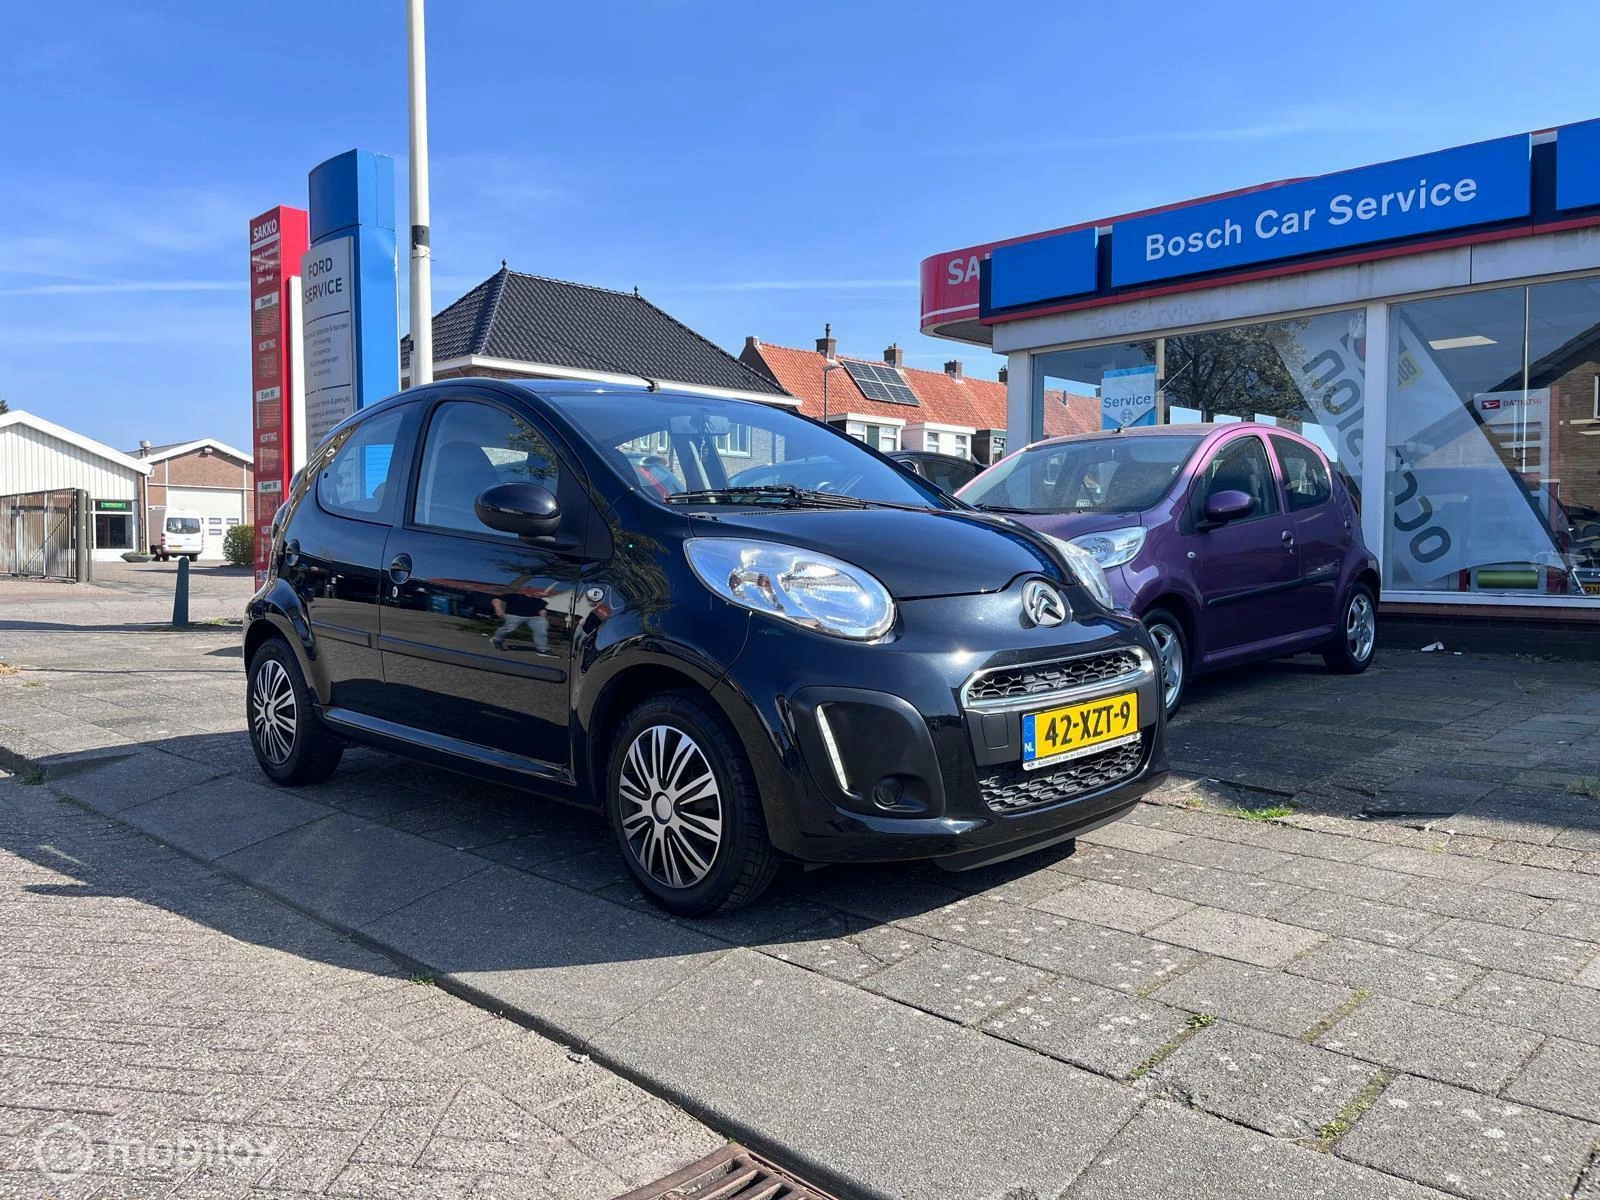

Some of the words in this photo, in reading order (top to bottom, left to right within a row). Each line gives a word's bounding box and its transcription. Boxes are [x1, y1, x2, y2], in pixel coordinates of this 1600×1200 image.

[253, 218, 278, 242] SAKKO
[1145, 218, 1243, 262] Bosch
[1255, 207, 1316, 240] Car
[1328, 178, 1478, 226] Service
[308, 256, 333, 280] FORD
[947, 253, 991, 286] SA
[304, 277, 343, 305] SERVICE
[1103, 394, 1151, 409] Service
[1044, 700, 1131, 748] 42-XZT-9
[1024, 742, 1035, 752] NL
